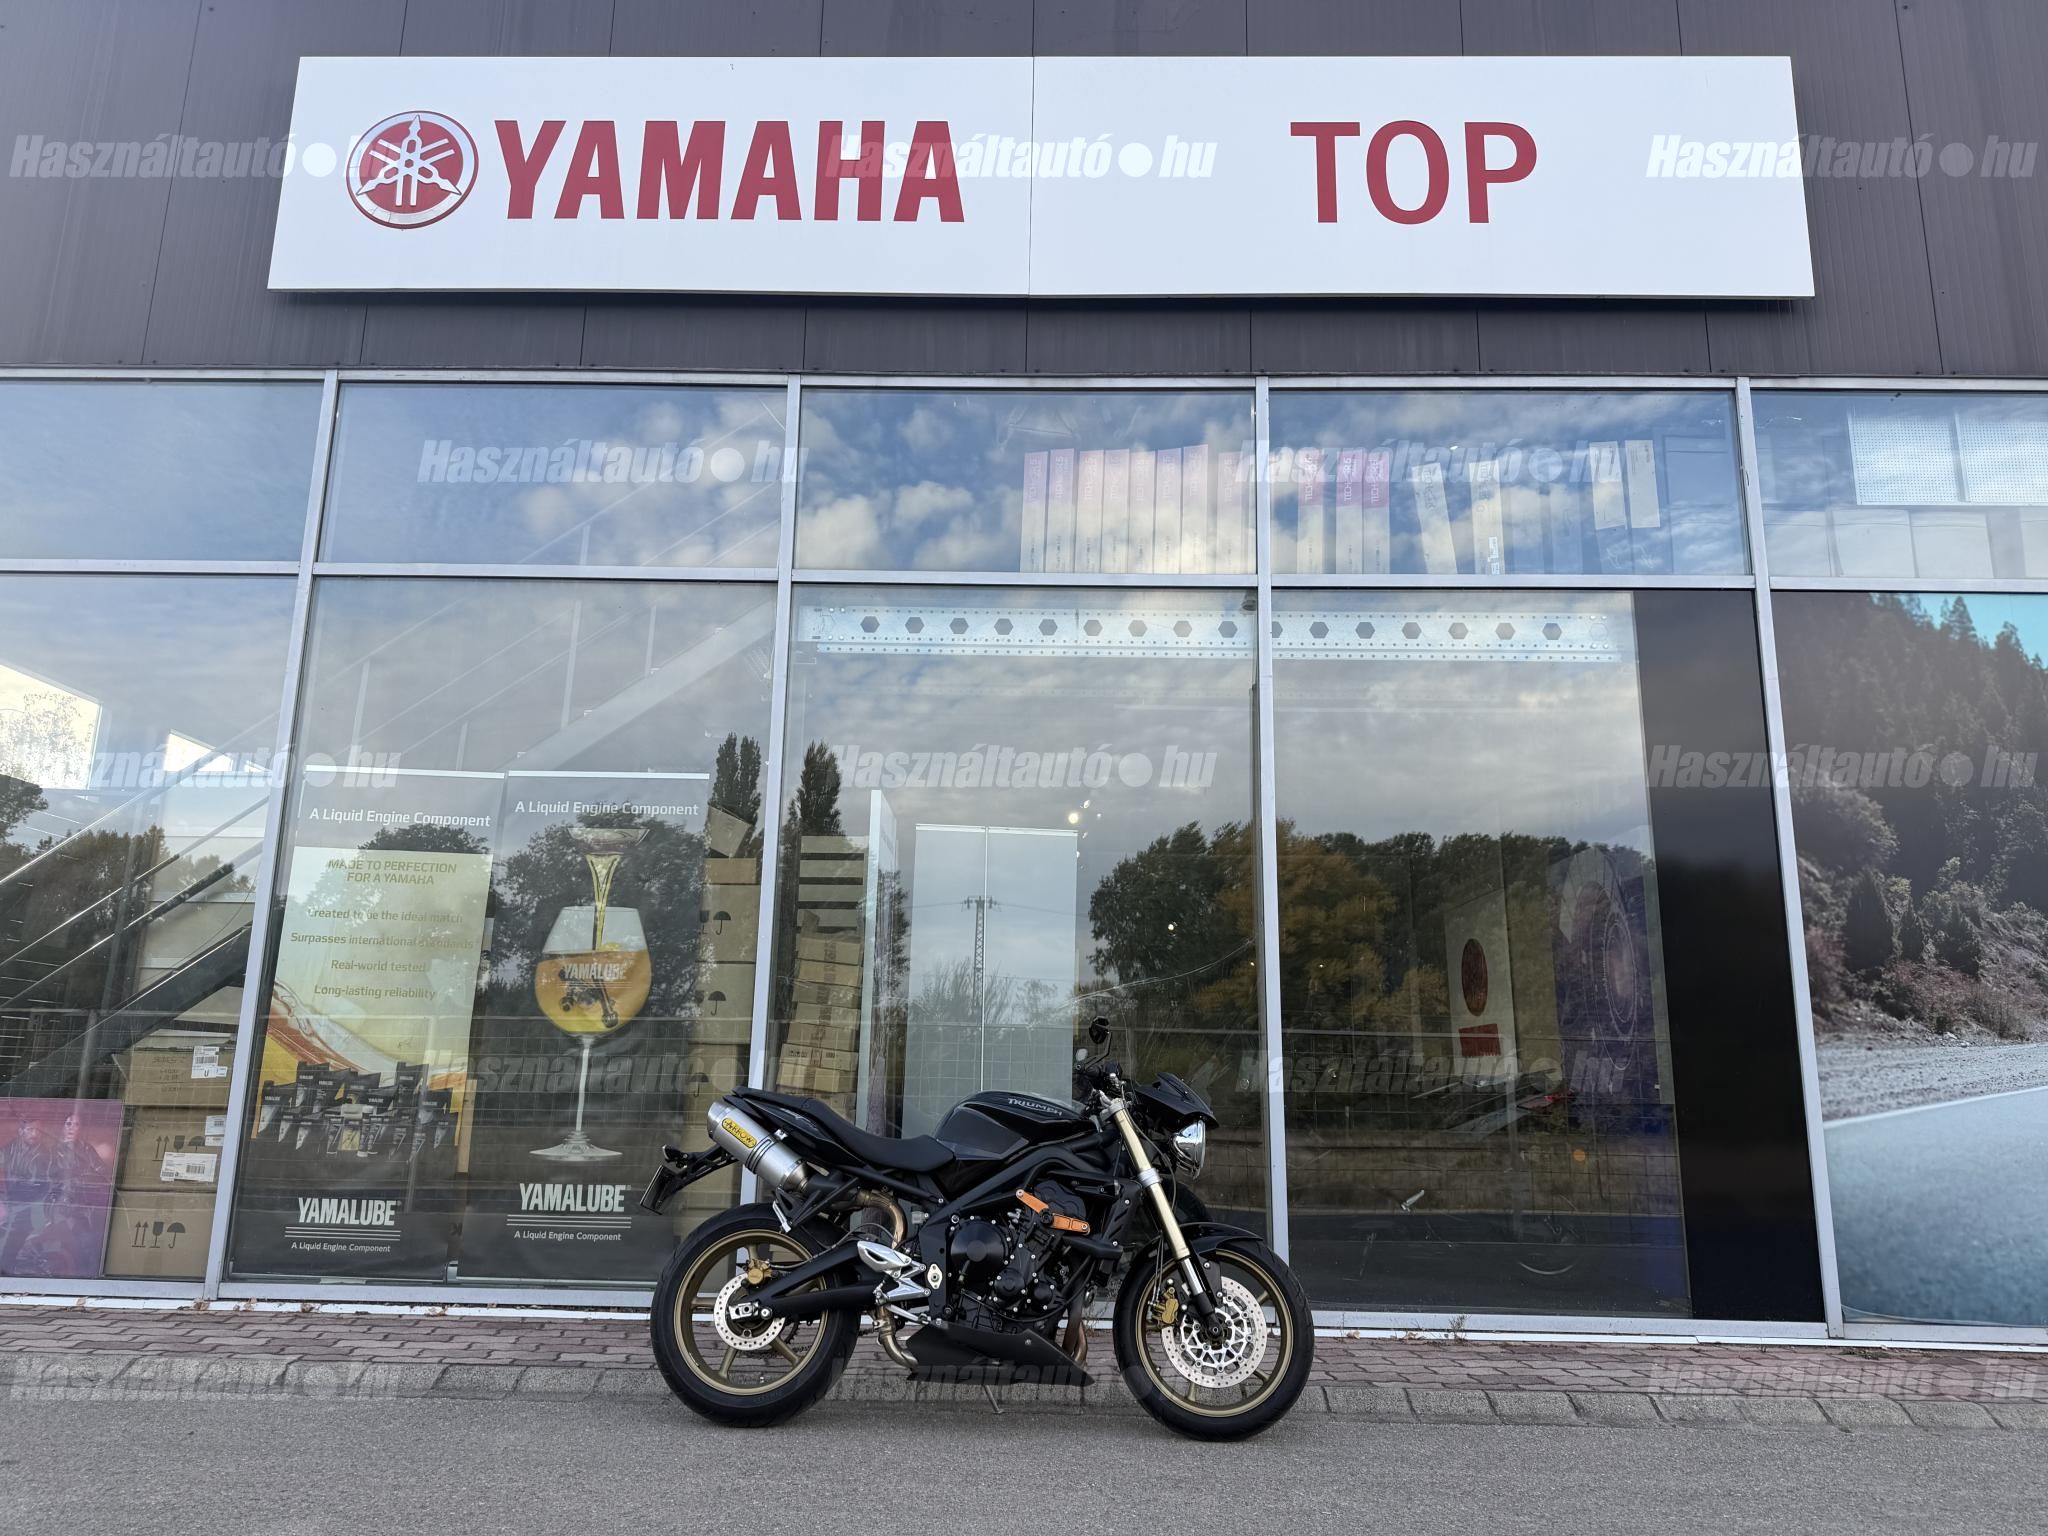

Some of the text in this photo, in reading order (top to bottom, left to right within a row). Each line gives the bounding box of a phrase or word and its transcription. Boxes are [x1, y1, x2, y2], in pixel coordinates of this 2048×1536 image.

[494, 120, 1537, 225] YAMAHA TOP
[515, 801, 699, 817] A Liquid Engine Component
[309, 808, 491, 827] A Liquid Engine Component
[367, 860, 381, 870] TO
[384, 860, 457, 873] PERFECTION
[347, 872, 434, 885] FOR A YAMAHA
[381, 910, 398, 921] the
[401, 911, 426, 922] ideal
[430, 912, 463, 924] match
[290, 932, 346, 945] Surpasses
[349, 934, 416, 948] international
[331, 959, 426, 973] Real-world tested
[563, 961, 627, 982] YAMALUBE
[314, 984, 436, 1001] Long-lasting reliability
[1007, 1097, 1063, 1116] TRIUMPH
[724, 1120, 755, 1144] ARROW
[518, 1183, 626, 1213] YAMALUBE
[298, 1197, 397, 1226] YAMALUBE
[514, 1231, 622, 1243] A Liquid Engine Component
[291, 1241, 391, 1254] A Liquid Engine Component
